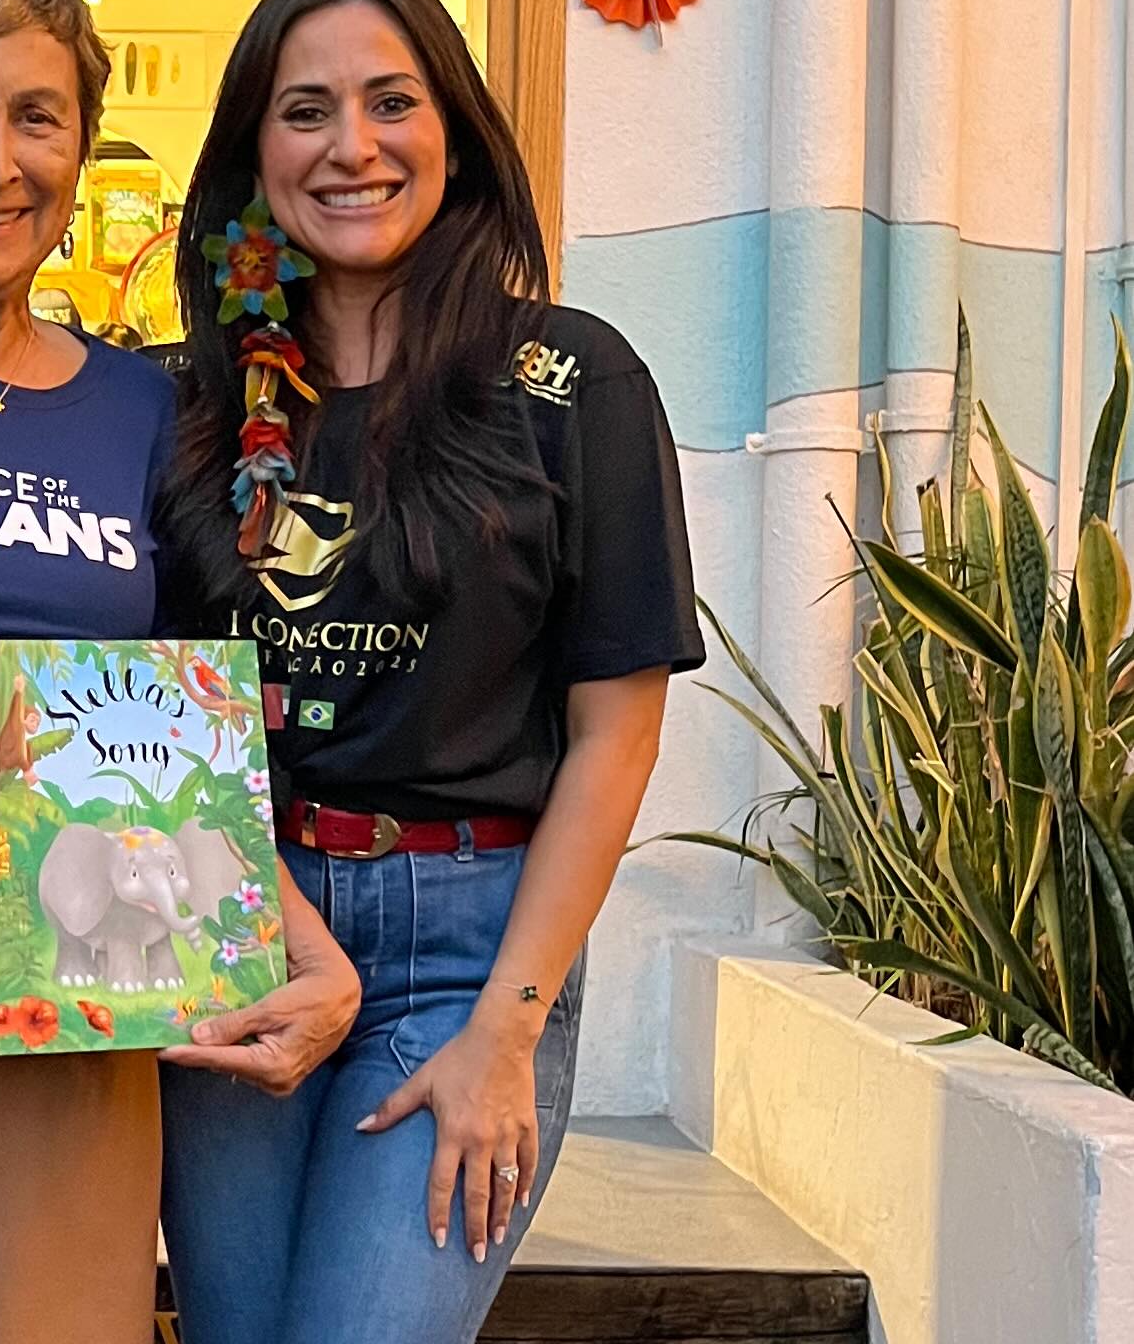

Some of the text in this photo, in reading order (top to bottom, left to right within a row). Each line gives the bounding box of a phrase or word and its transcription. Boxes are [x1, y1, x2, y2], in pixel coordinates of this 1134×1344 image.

[41, 476, 69, 493] OF
[43, 492, 81, 510] THE
[45, 668, 193, 733] Stella's
[86, 728, 172, 771] Song
